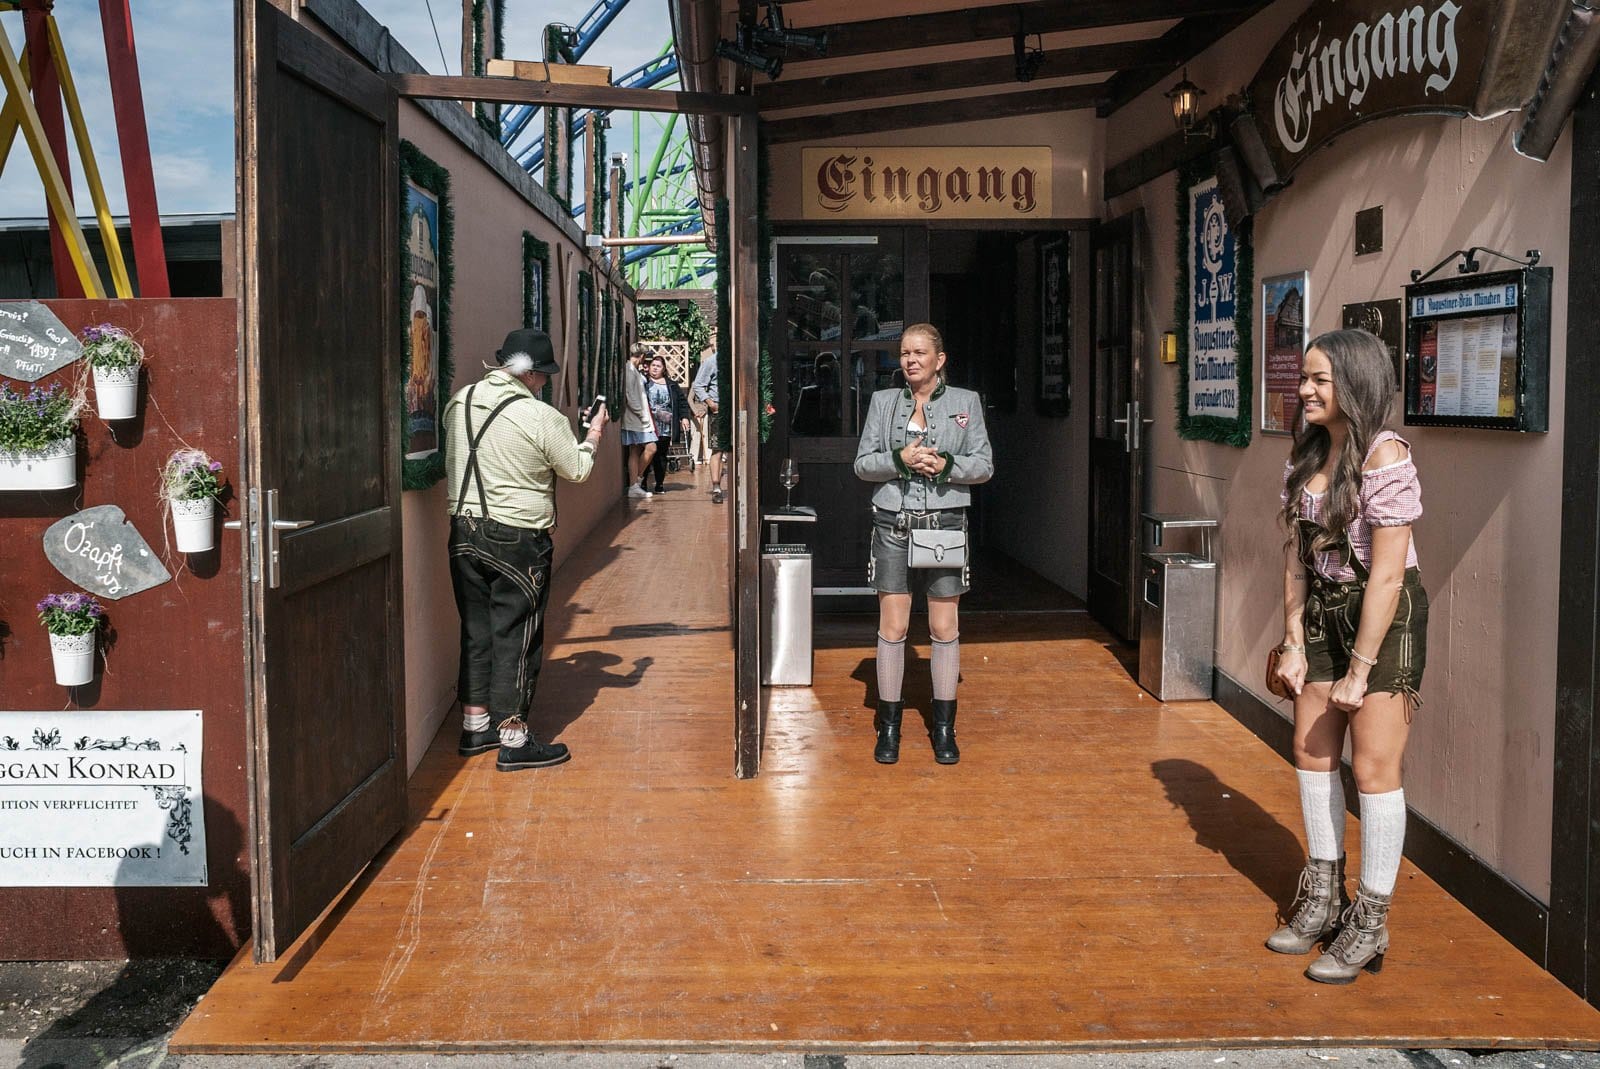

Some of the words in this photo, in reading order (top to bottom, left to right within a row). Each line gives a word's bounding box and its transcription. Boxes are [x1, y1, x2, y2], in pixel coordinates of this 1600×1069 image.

[1273, 0, 1463, 153] Eingang
[816, 153, 1039, 213] Eingang
[67, 756, 175, 779] KONRAD
[43, 799, 138, 810] VERPFLICHTET
[43, 847, 61, 859] IN
[67, 847, 151, 859] FACEBOOK
